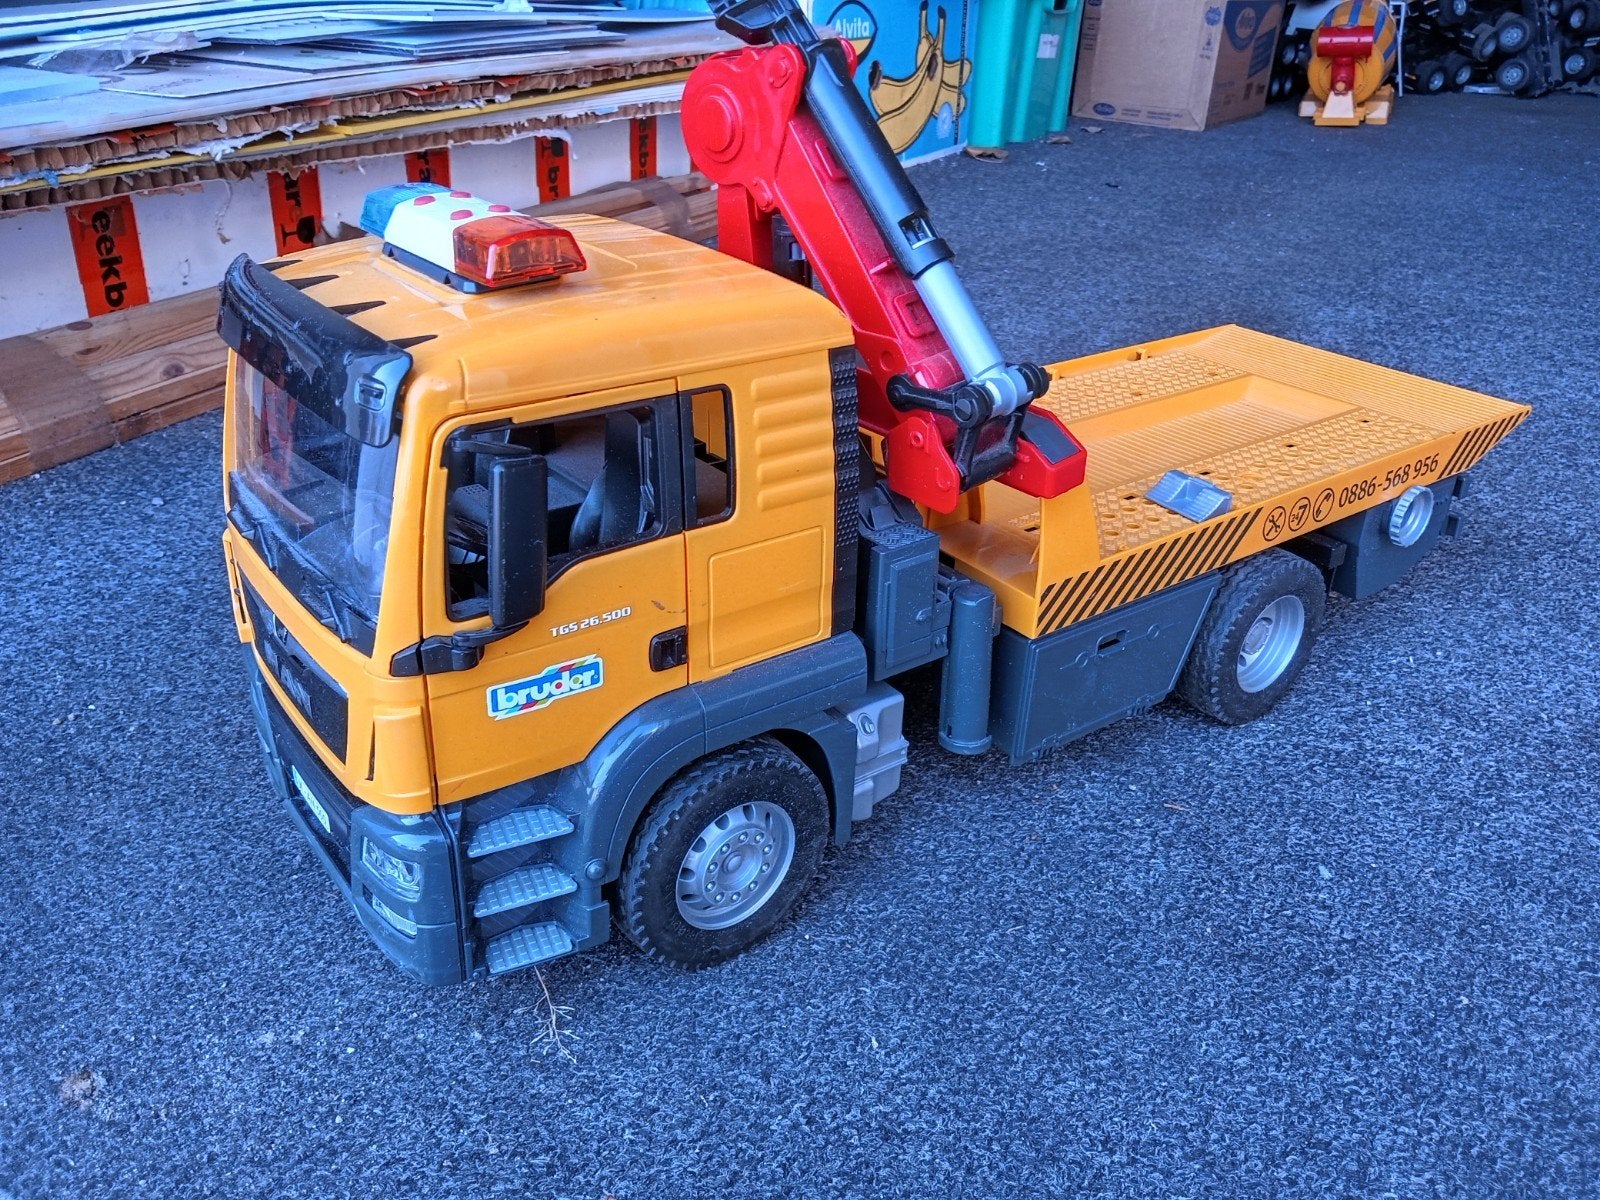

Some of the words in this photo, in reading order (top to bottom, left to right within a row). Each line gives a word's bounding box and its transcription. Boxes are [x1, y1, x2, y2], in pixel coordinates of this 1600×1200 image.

[834, 17, 870, 39] Alvita
[91, 210, 129, 312] eekb
[1338, 464, 1411, 507] 0886-568
[1412, 453, 1439, 479] 956
[550, 622, 578, 637] TGS
[580, 606, 631, 628] 26.500
[496, 669, 596, 711] bruder
